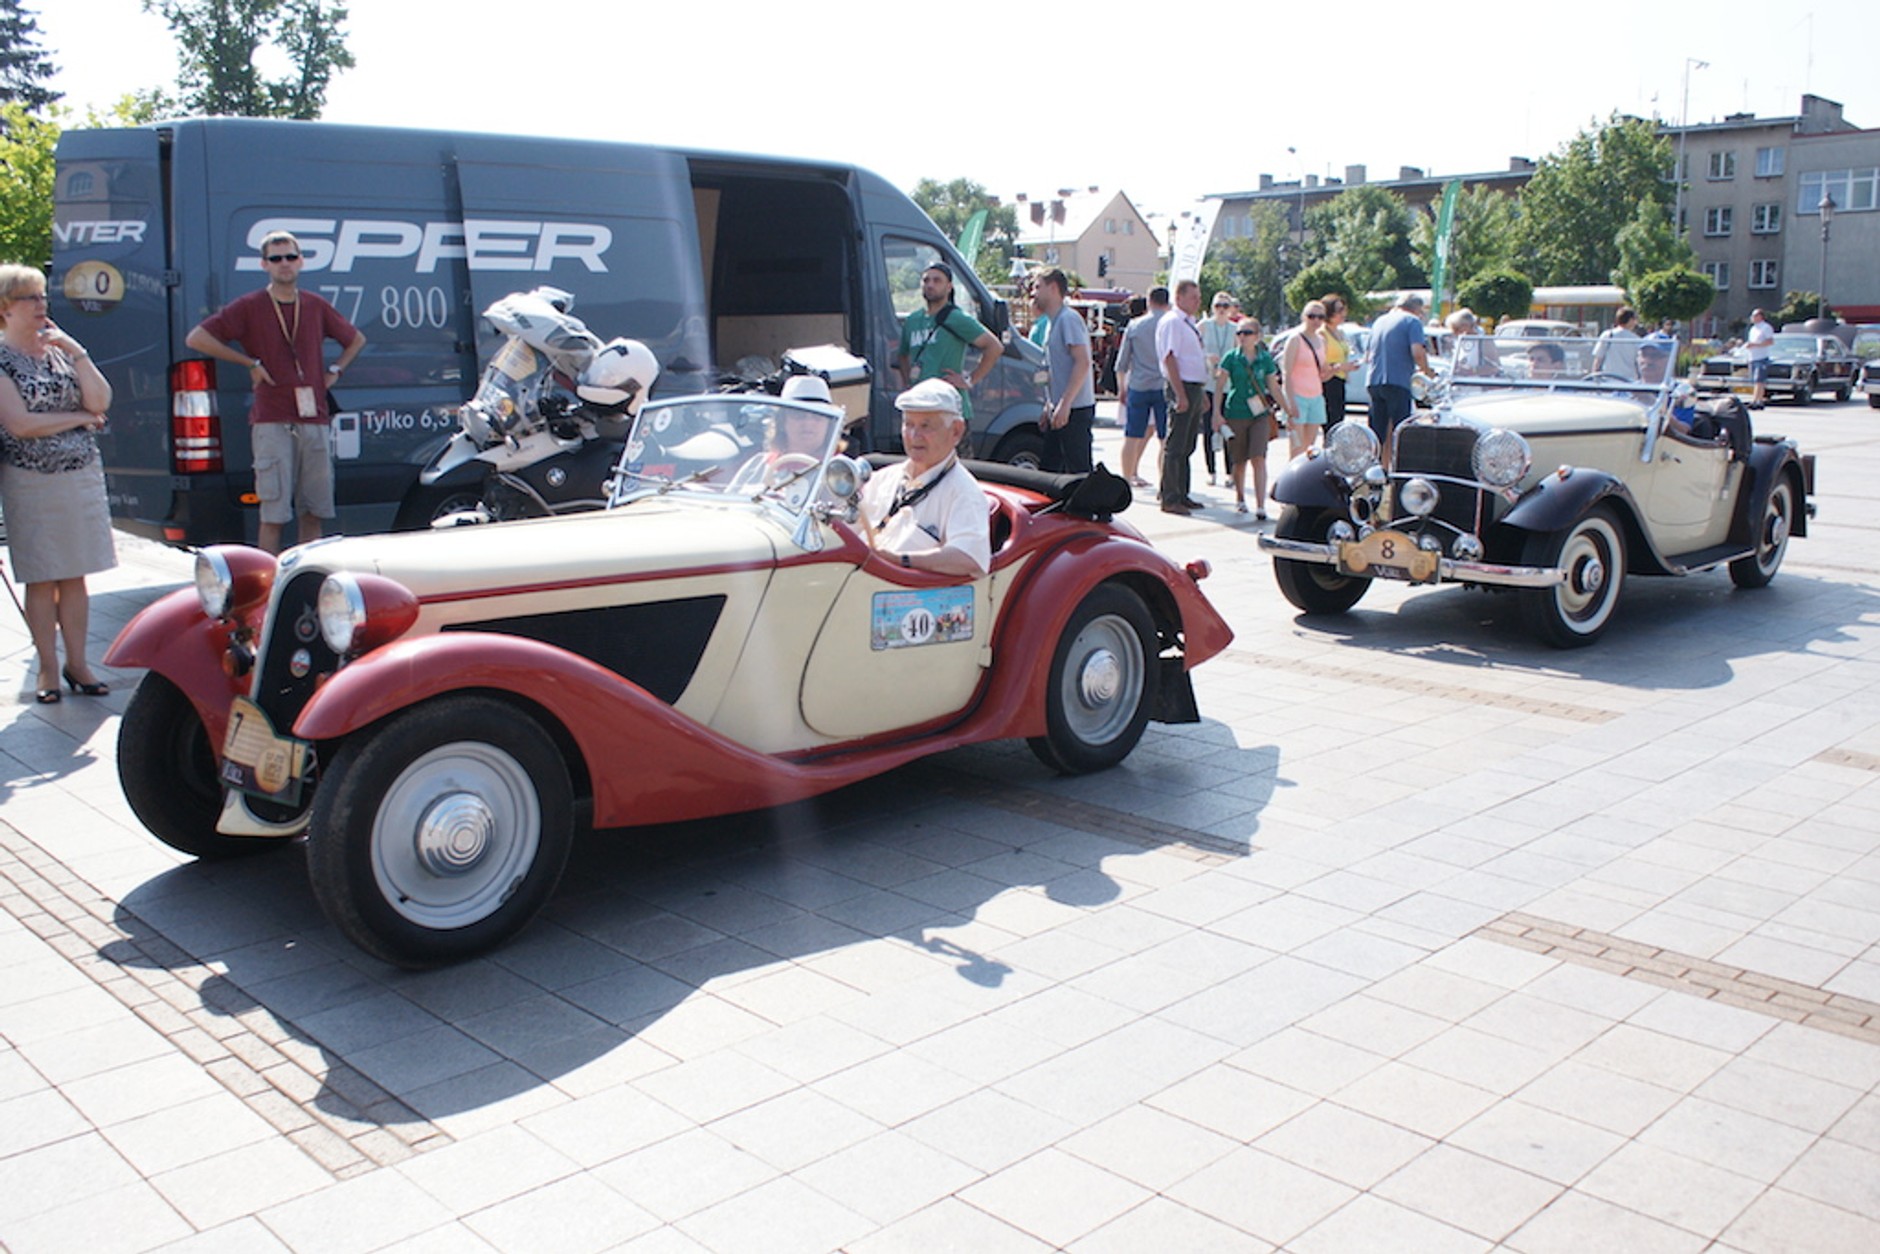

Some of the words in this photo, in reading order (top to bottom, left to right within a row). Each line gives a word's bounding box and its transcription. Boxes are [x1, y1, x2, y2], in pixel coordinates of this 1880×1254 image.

[381, 286, 448, 328] 800
[364, 410, 414, 434] Tylko
[420, 409, 450, 432] 6,3
[1381, 539, 1395, 560] 8
[907, 613, 930, 638] 40
